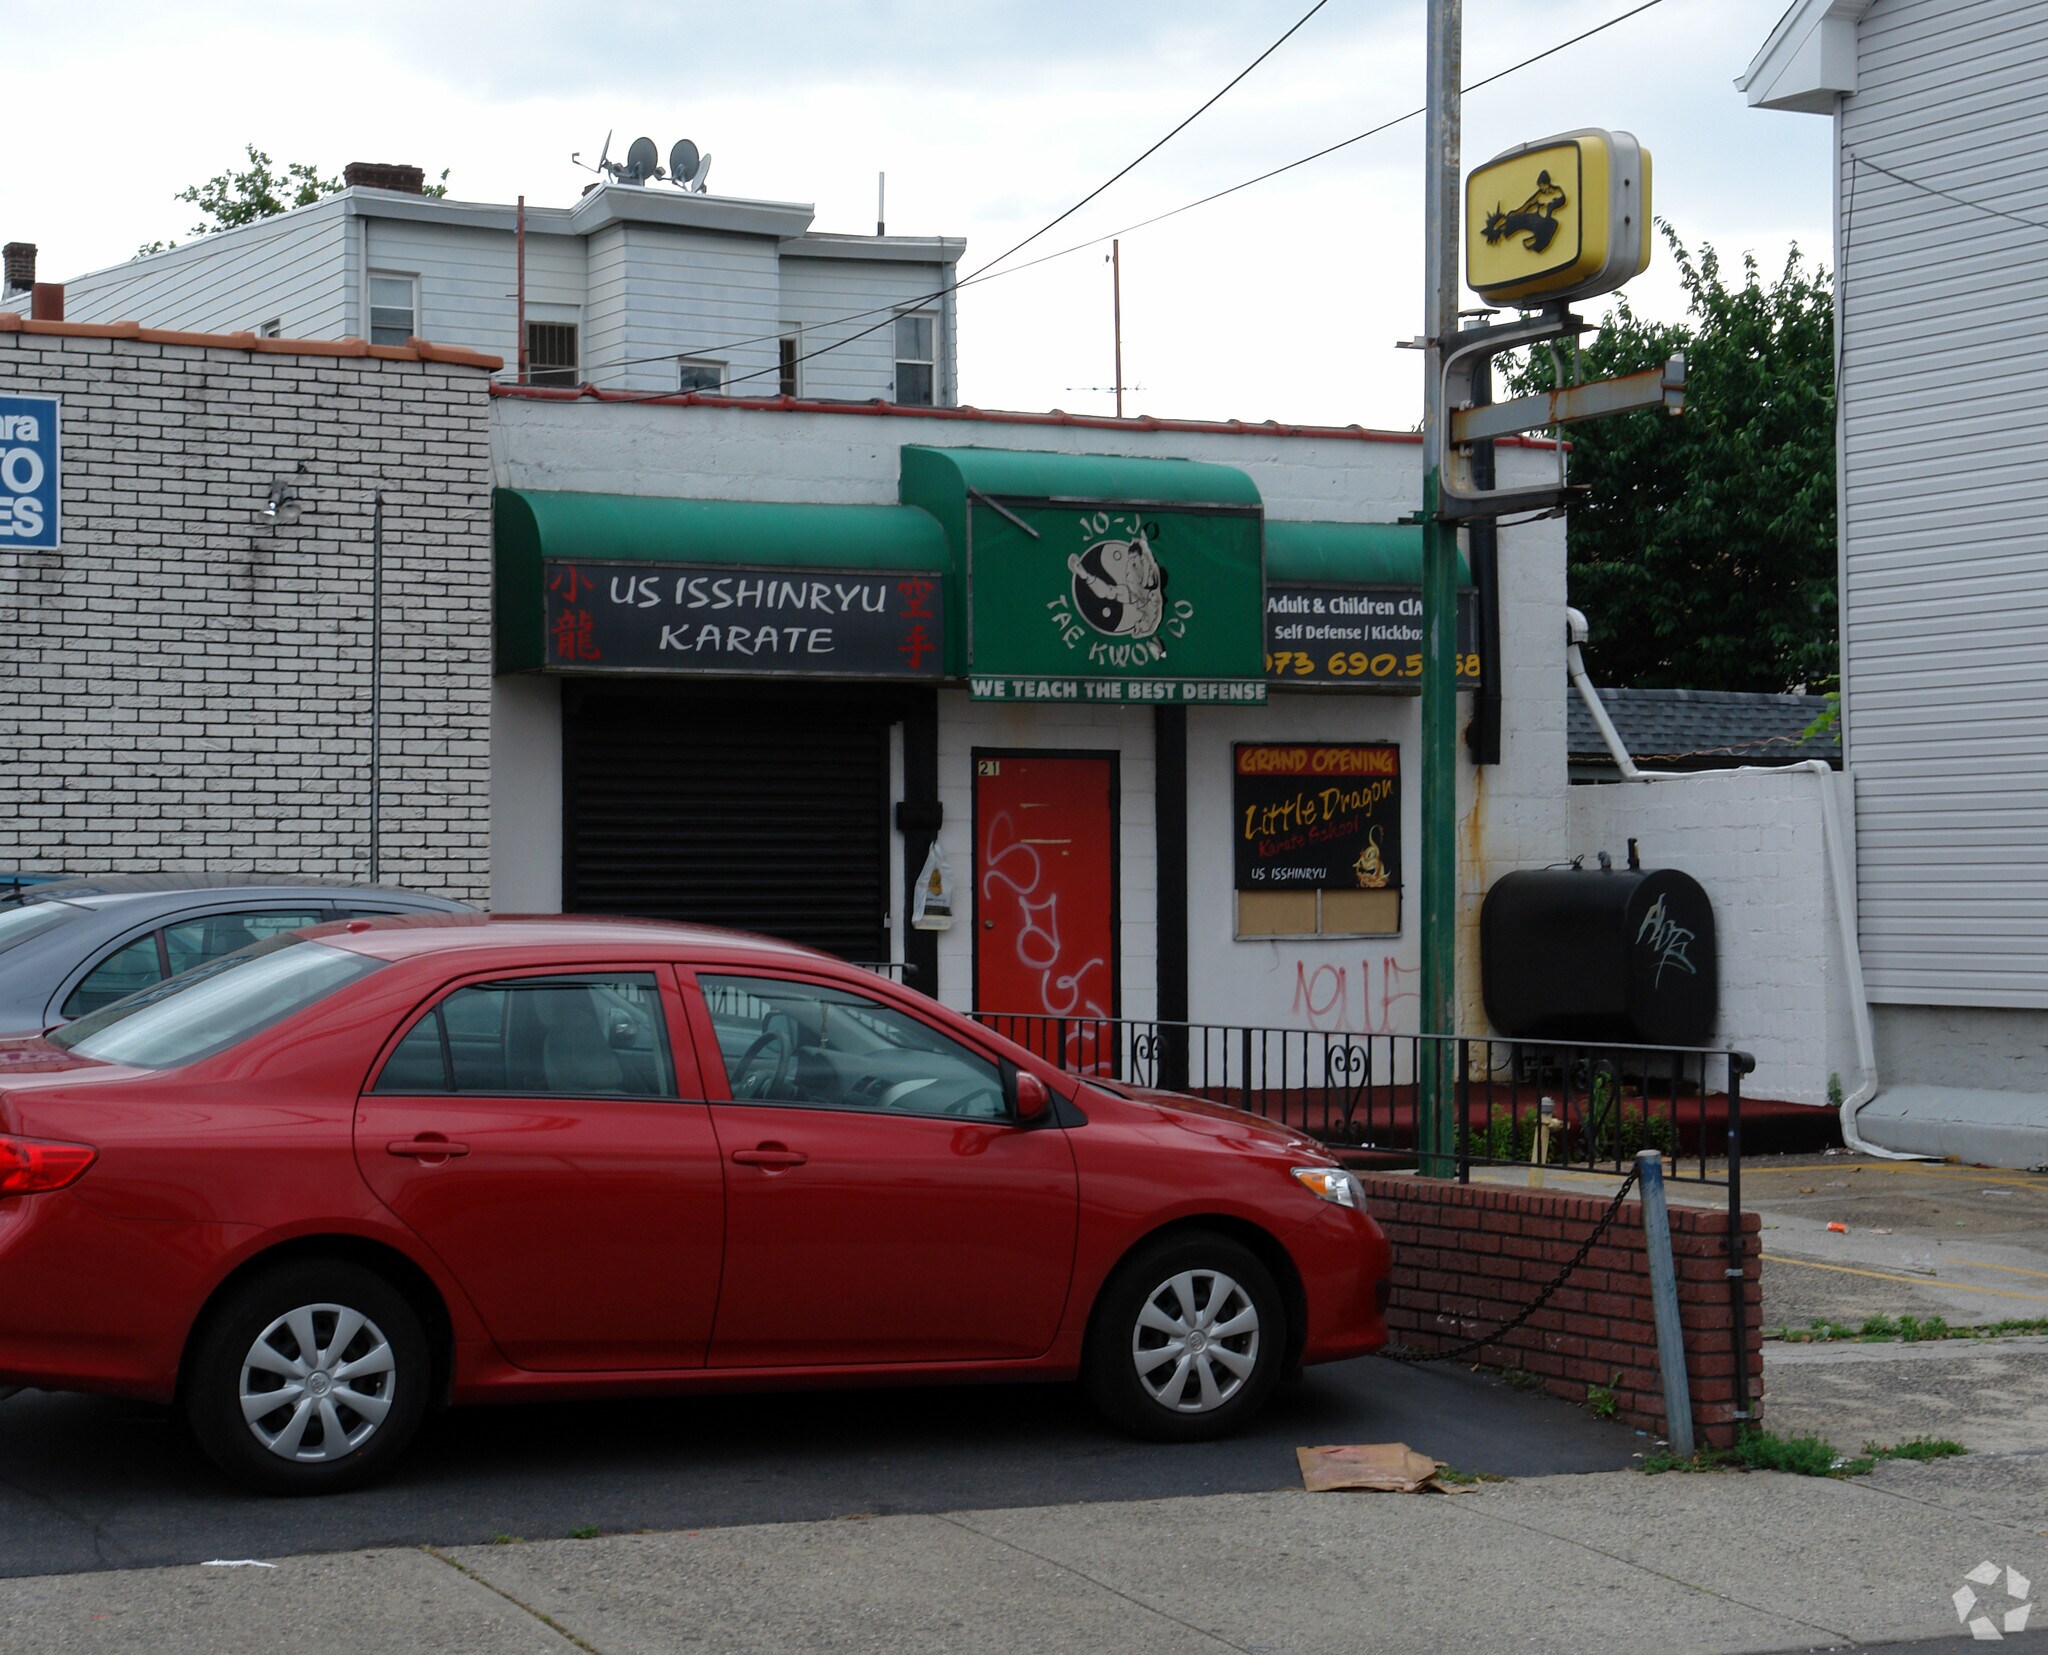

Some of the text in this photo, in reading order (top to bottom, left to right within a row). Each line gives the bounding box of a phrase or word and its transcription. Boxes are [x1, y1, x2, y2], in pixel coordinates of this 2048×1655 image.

[0, 446, 44, 494] O
[610, 576, 886, 615] US ISSHINRYU
[1267, 595, 1310, 614] Adult
[1313, 598, 1326, 614] &
[1330, 597, 1394, 616] Children
[898, 576, 935, 669] 空手
[1046, 594, 1086, 650] TAE
[1166, 600, 1194, 639] DO
[1275, 624, 1302, 640] Self
[1306, 625, 1362, 640] Defense
[1372, 626, 1422, 641] Kickbo
[659, 623, 835, 656] KARATE
[1327, 651, 1480, 677] 690.58
[971, 680, 1267, 700] WE TEACH THE BEST DEFENSE
[980, 762, 997, 775] 21
[1241, 749, 1393, 773] GRAND OPENING
[1245, 779, 1394, 840] Little Dragon
[1258, 815, 1358, 858] Karate School
[1251, 867, 1327, 880] US ISSHINRYU
